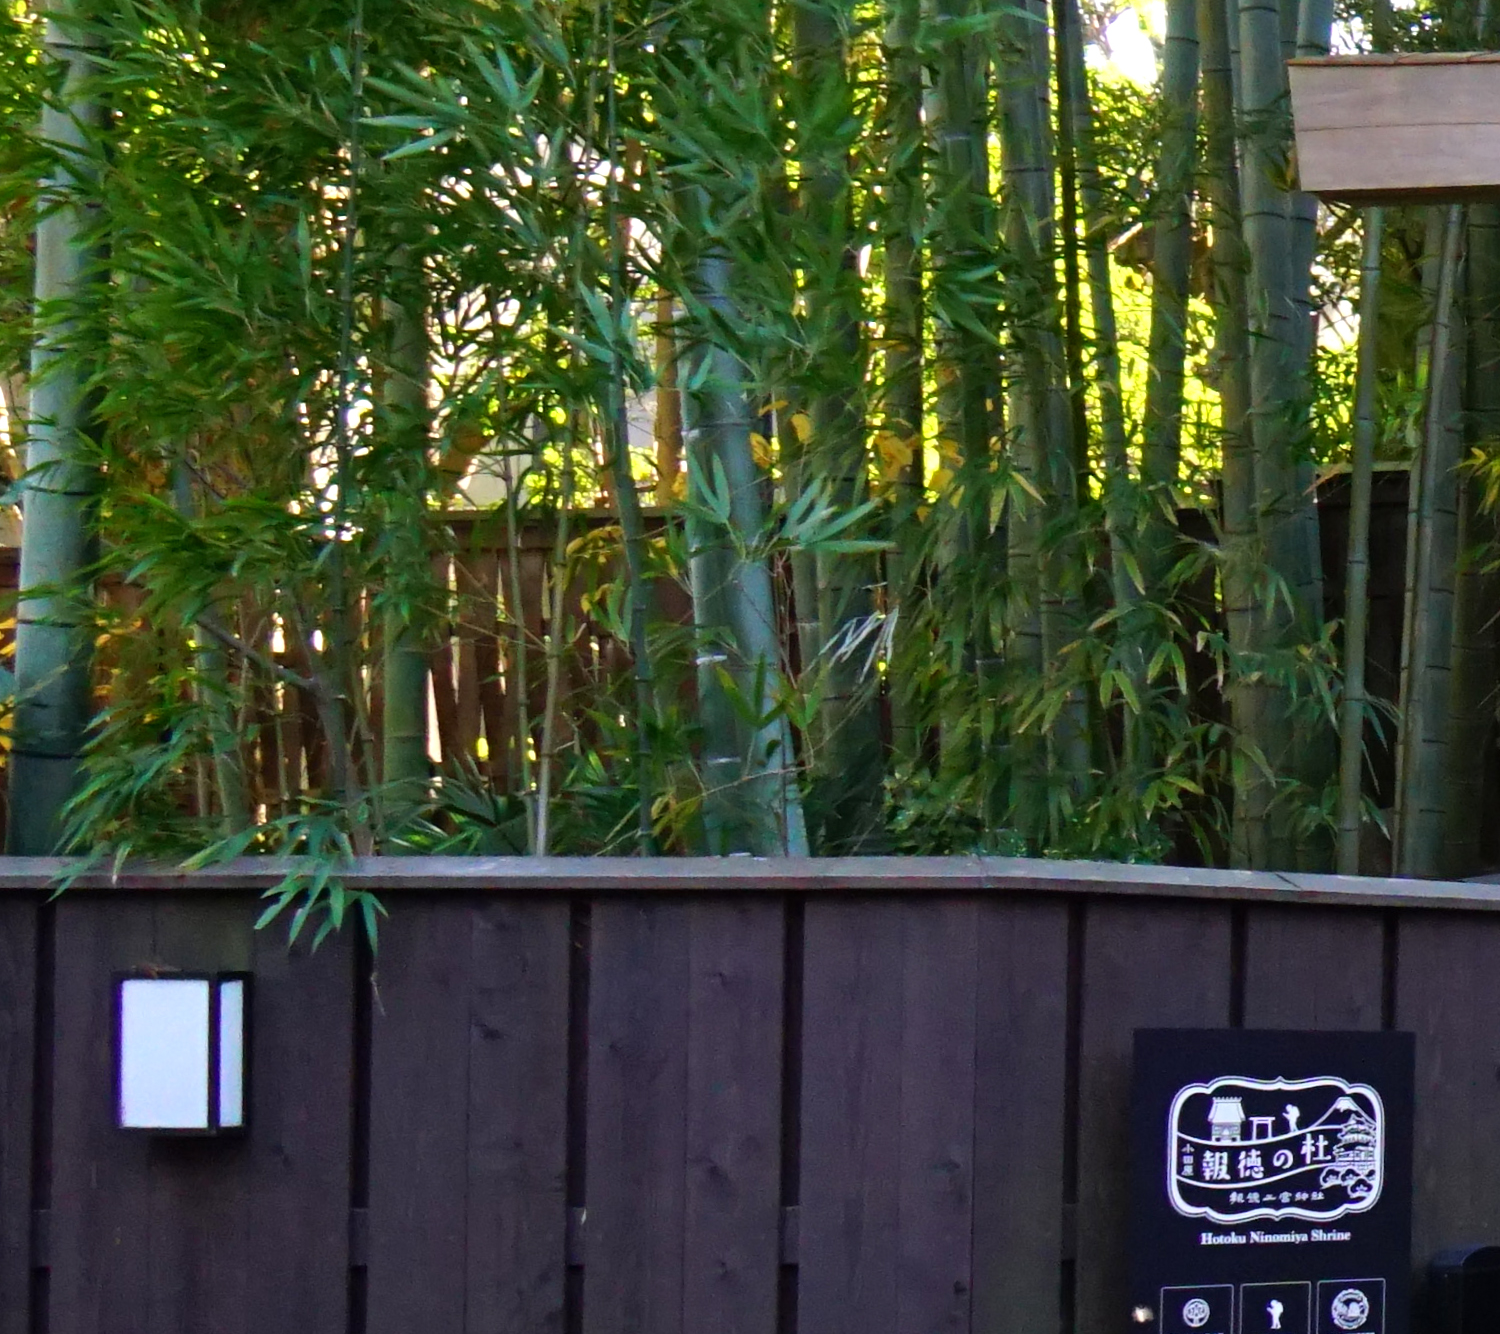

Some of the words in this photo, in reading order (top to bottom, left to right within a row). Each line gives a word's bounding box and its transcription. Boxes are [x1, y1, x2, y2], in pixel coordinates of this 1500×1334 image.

[1202, 1133, 1332, 1181] 報徳の杜
[1201, 1232, 1247, 1245] Hotoku
[1250, 1230, 1309, 1245] Ninomiya
[1311, 1228, 1352, 1242] Shrine
